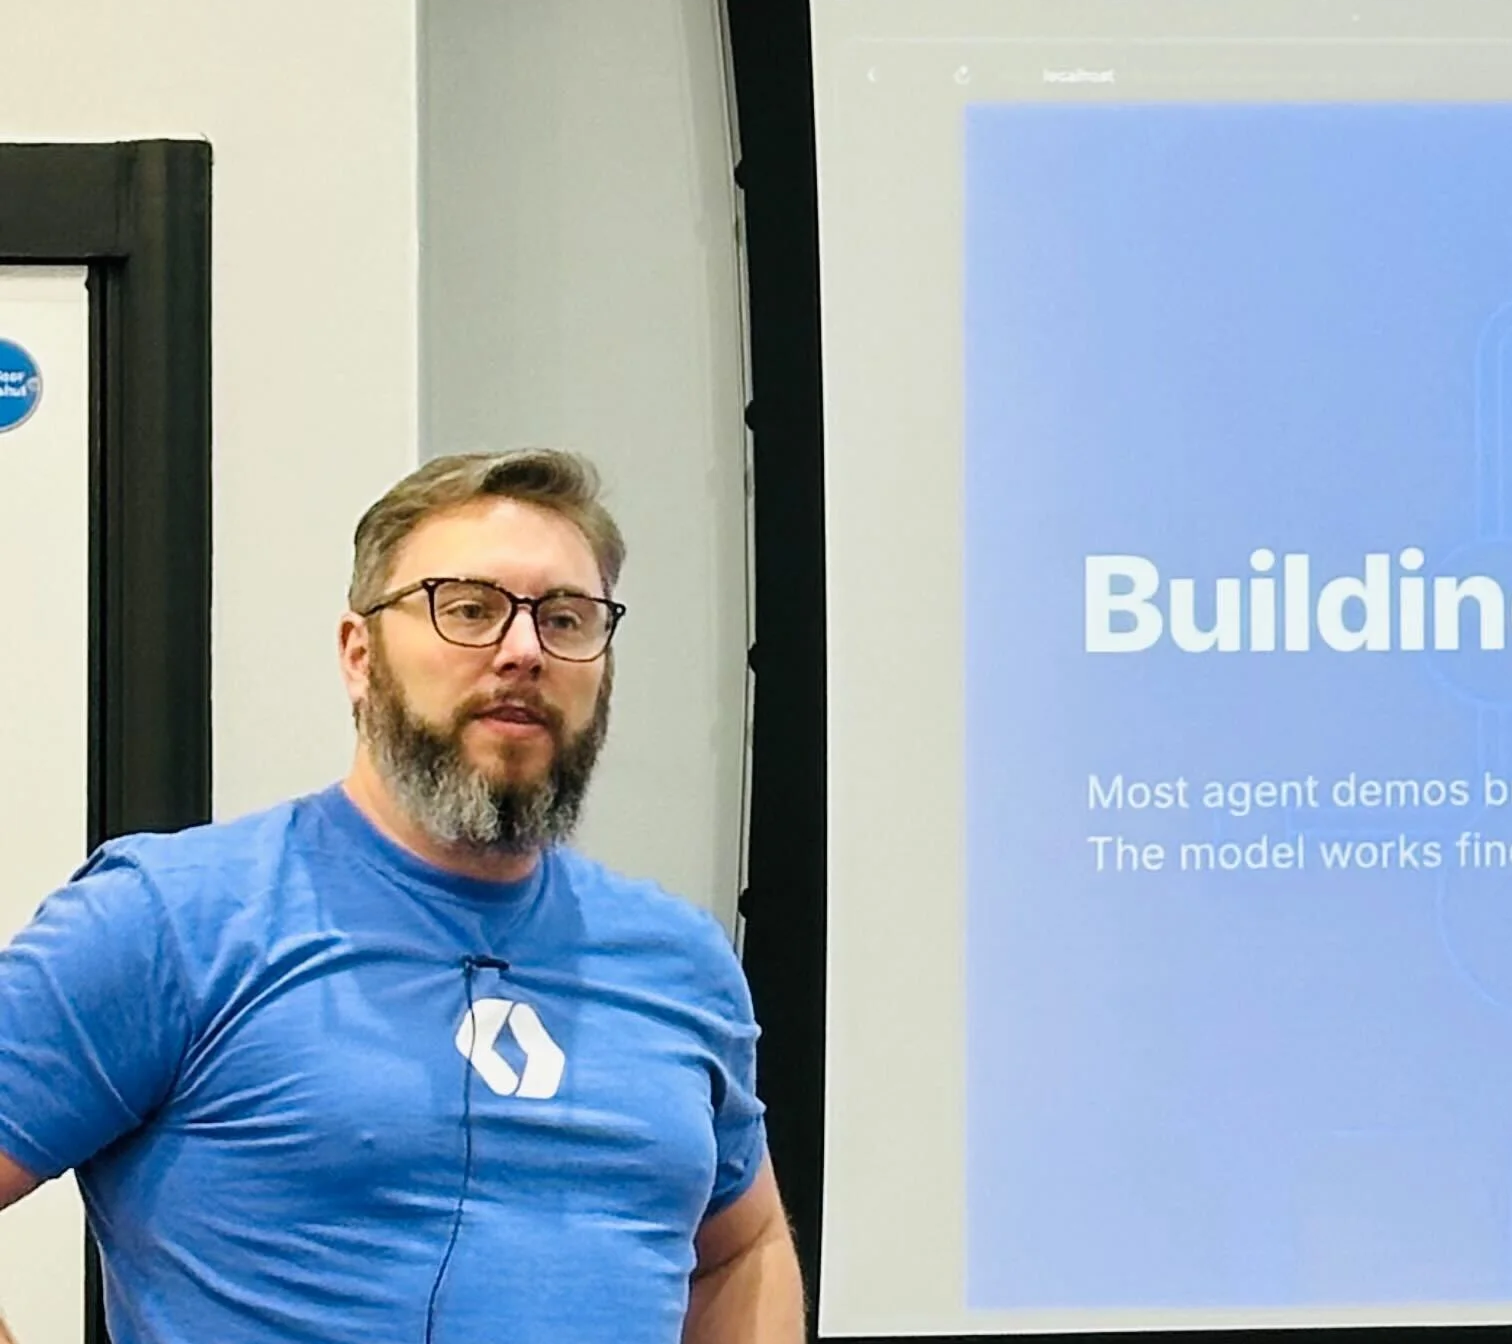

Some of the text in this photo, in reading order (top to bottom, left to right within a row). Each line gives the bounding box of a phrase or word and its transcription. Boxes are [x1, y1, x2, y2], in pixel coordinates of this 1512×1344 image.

[1088, 774, 1189, 809] Most
[1203, 775, 1319, 817] agent
[1332, 772, 1469, 807] demos
[1087, 836, 1165, 871] The
[1180, 835, 1304, 870] model
[1319, 833, 1442, 869] works
